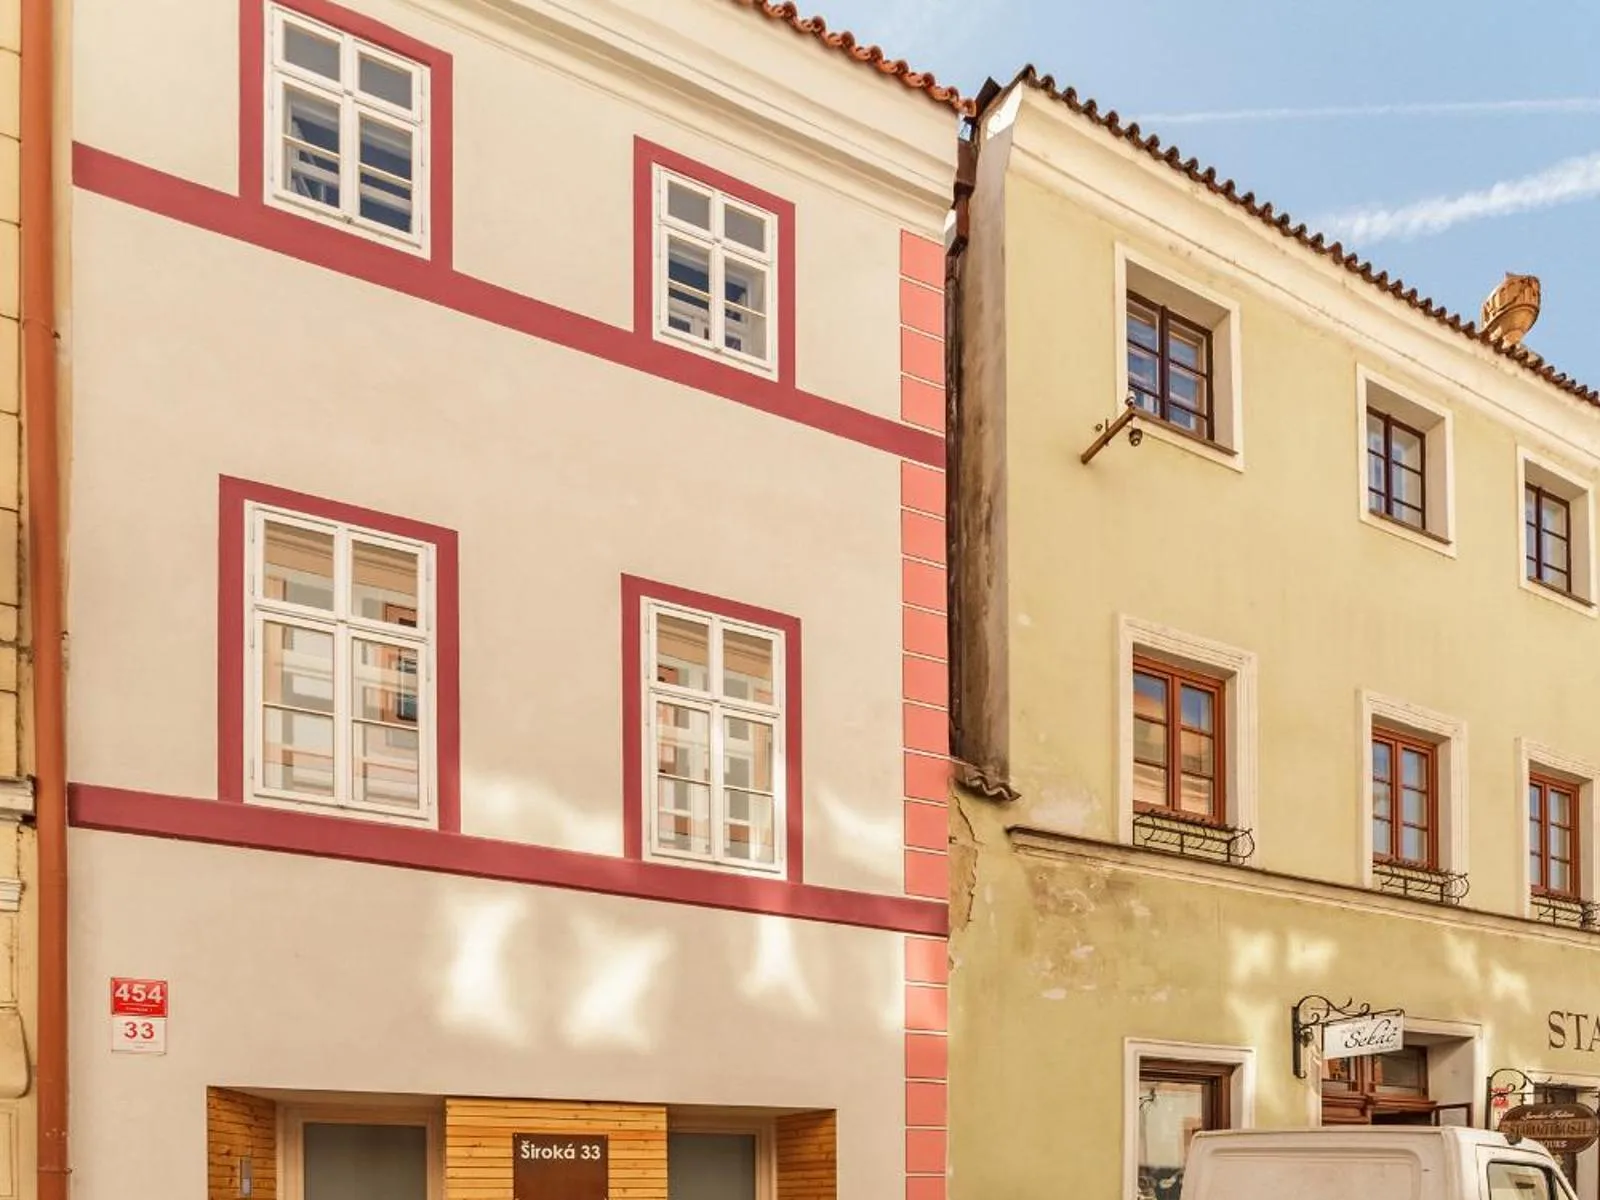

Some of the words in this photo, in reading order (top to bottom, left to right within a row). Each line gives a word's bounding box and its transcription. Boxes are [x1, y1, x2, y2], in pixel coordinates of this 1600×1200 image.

[115, 983, 163, 1003] 454
[124, 1021, 155, 1039] 33
[520, 1140, 576, 1160] Široká
[580, 1145, 601, 1160] 33
